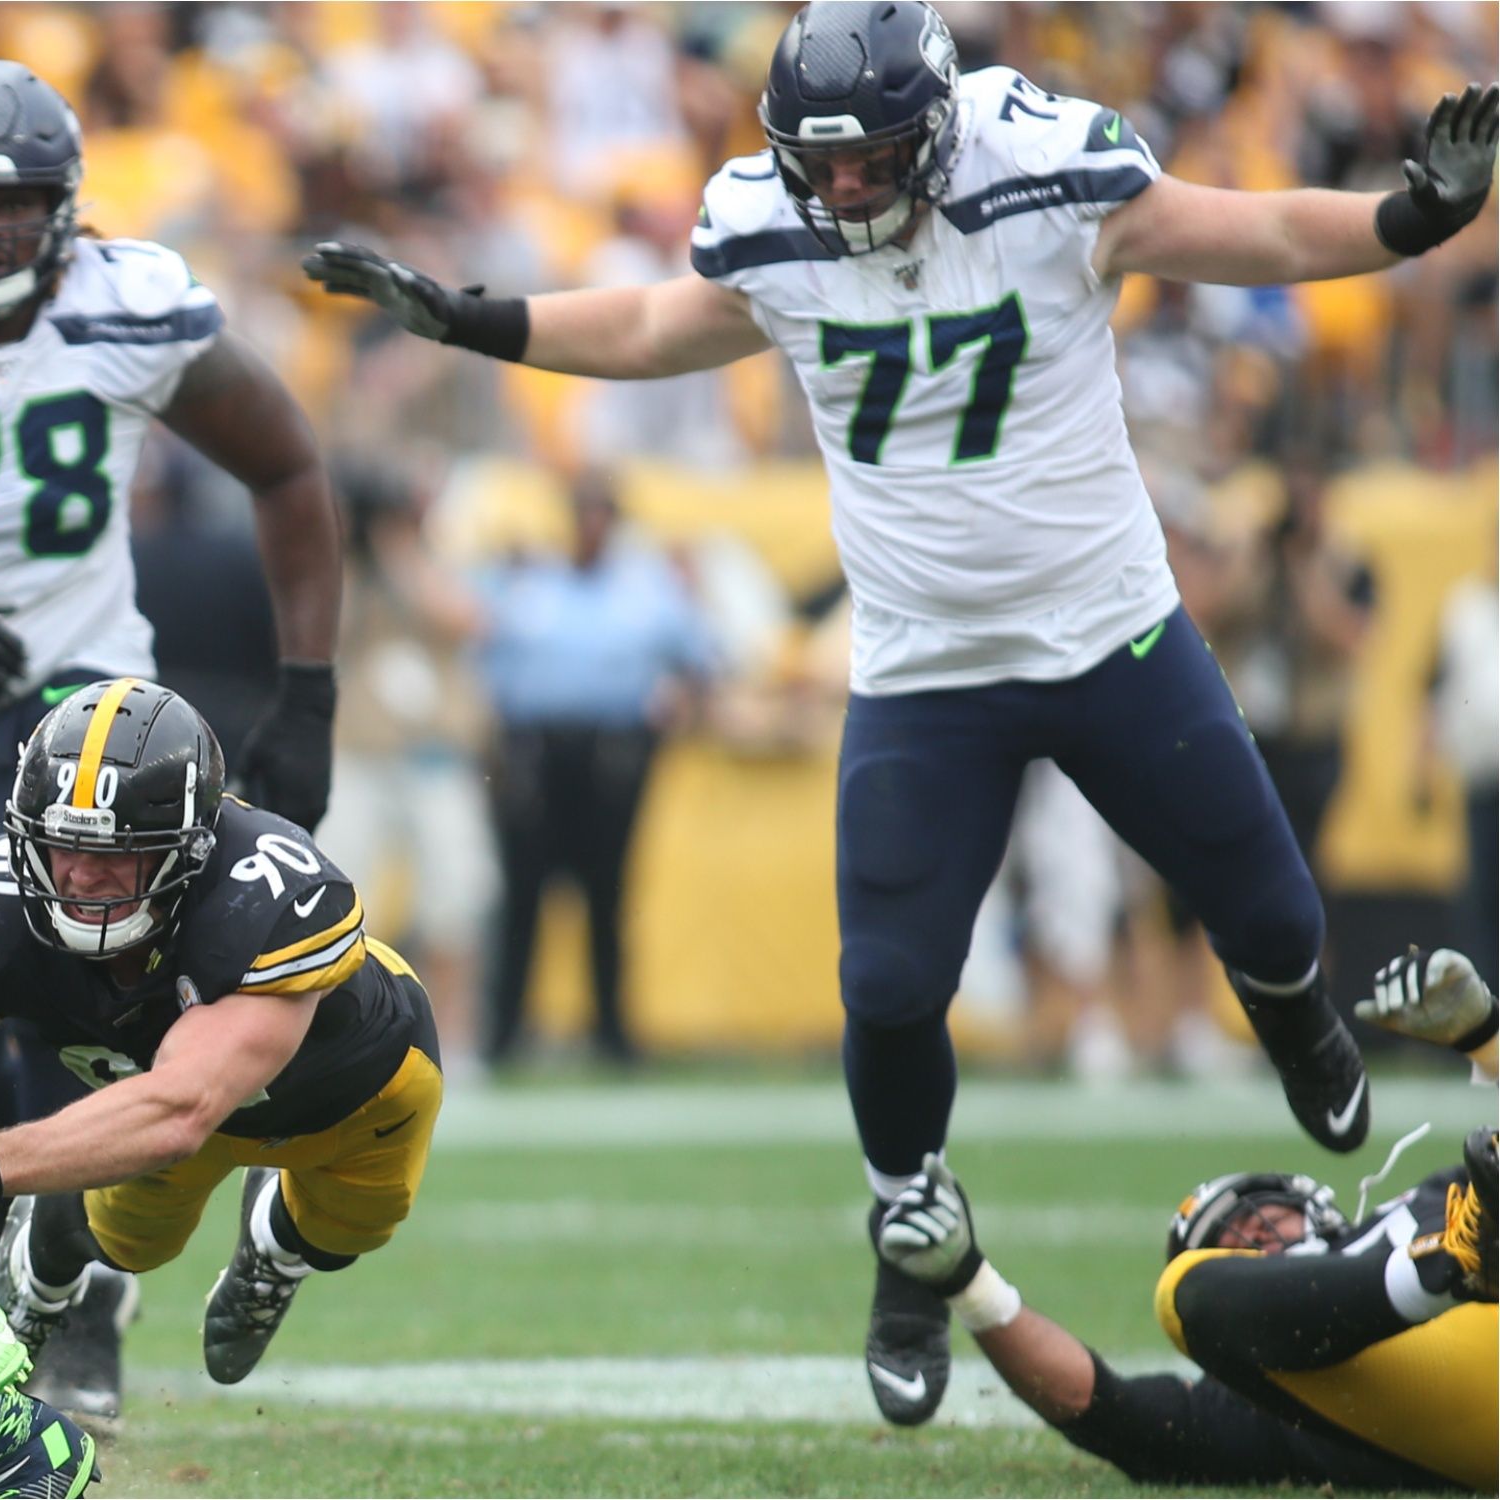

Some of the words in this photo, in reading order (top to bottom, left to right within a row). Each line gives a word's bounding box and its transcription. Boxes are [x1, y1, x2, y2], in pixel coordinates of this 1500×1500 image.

[818, 289, 1031, 467] 77
[53, 761, 119, 809] 90
[63, 808, 99, 826] Steelers
[229, 833, 321, 901] 90
